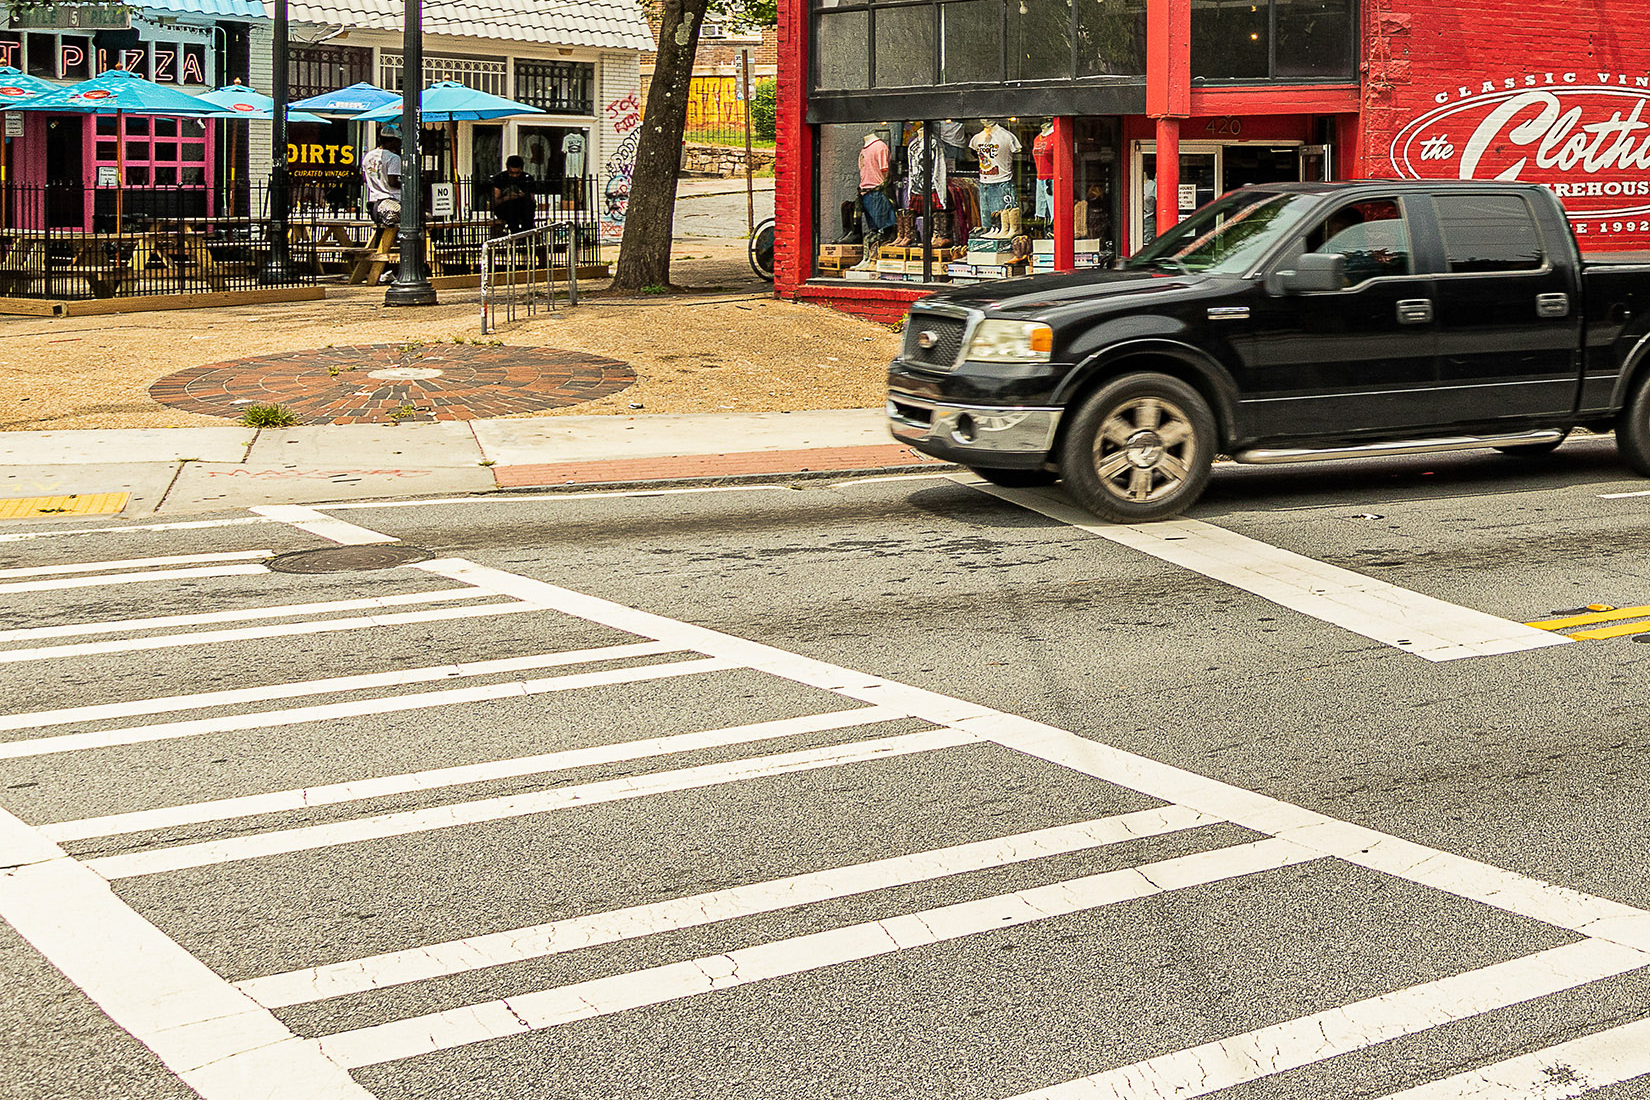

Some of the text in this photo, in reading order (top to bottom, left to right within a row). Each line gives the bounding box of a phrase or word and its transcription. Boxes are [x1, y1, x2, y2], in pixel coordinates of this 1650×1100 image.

[71, 10, 79, 25] 5
[90, 8, 127, 25] PIZZA
[61, 45, 204, 83] PIZZA
[1435, 72, 1577, 104] CLASSIC
[1205, 119, 1242, 136] 420
[1420, 134, 1455, 161] the
[324, 170, 350, 178] VINTAGE
[437, 188, 449, 196] NO
[1600, 220, 1650, 233] 1992
